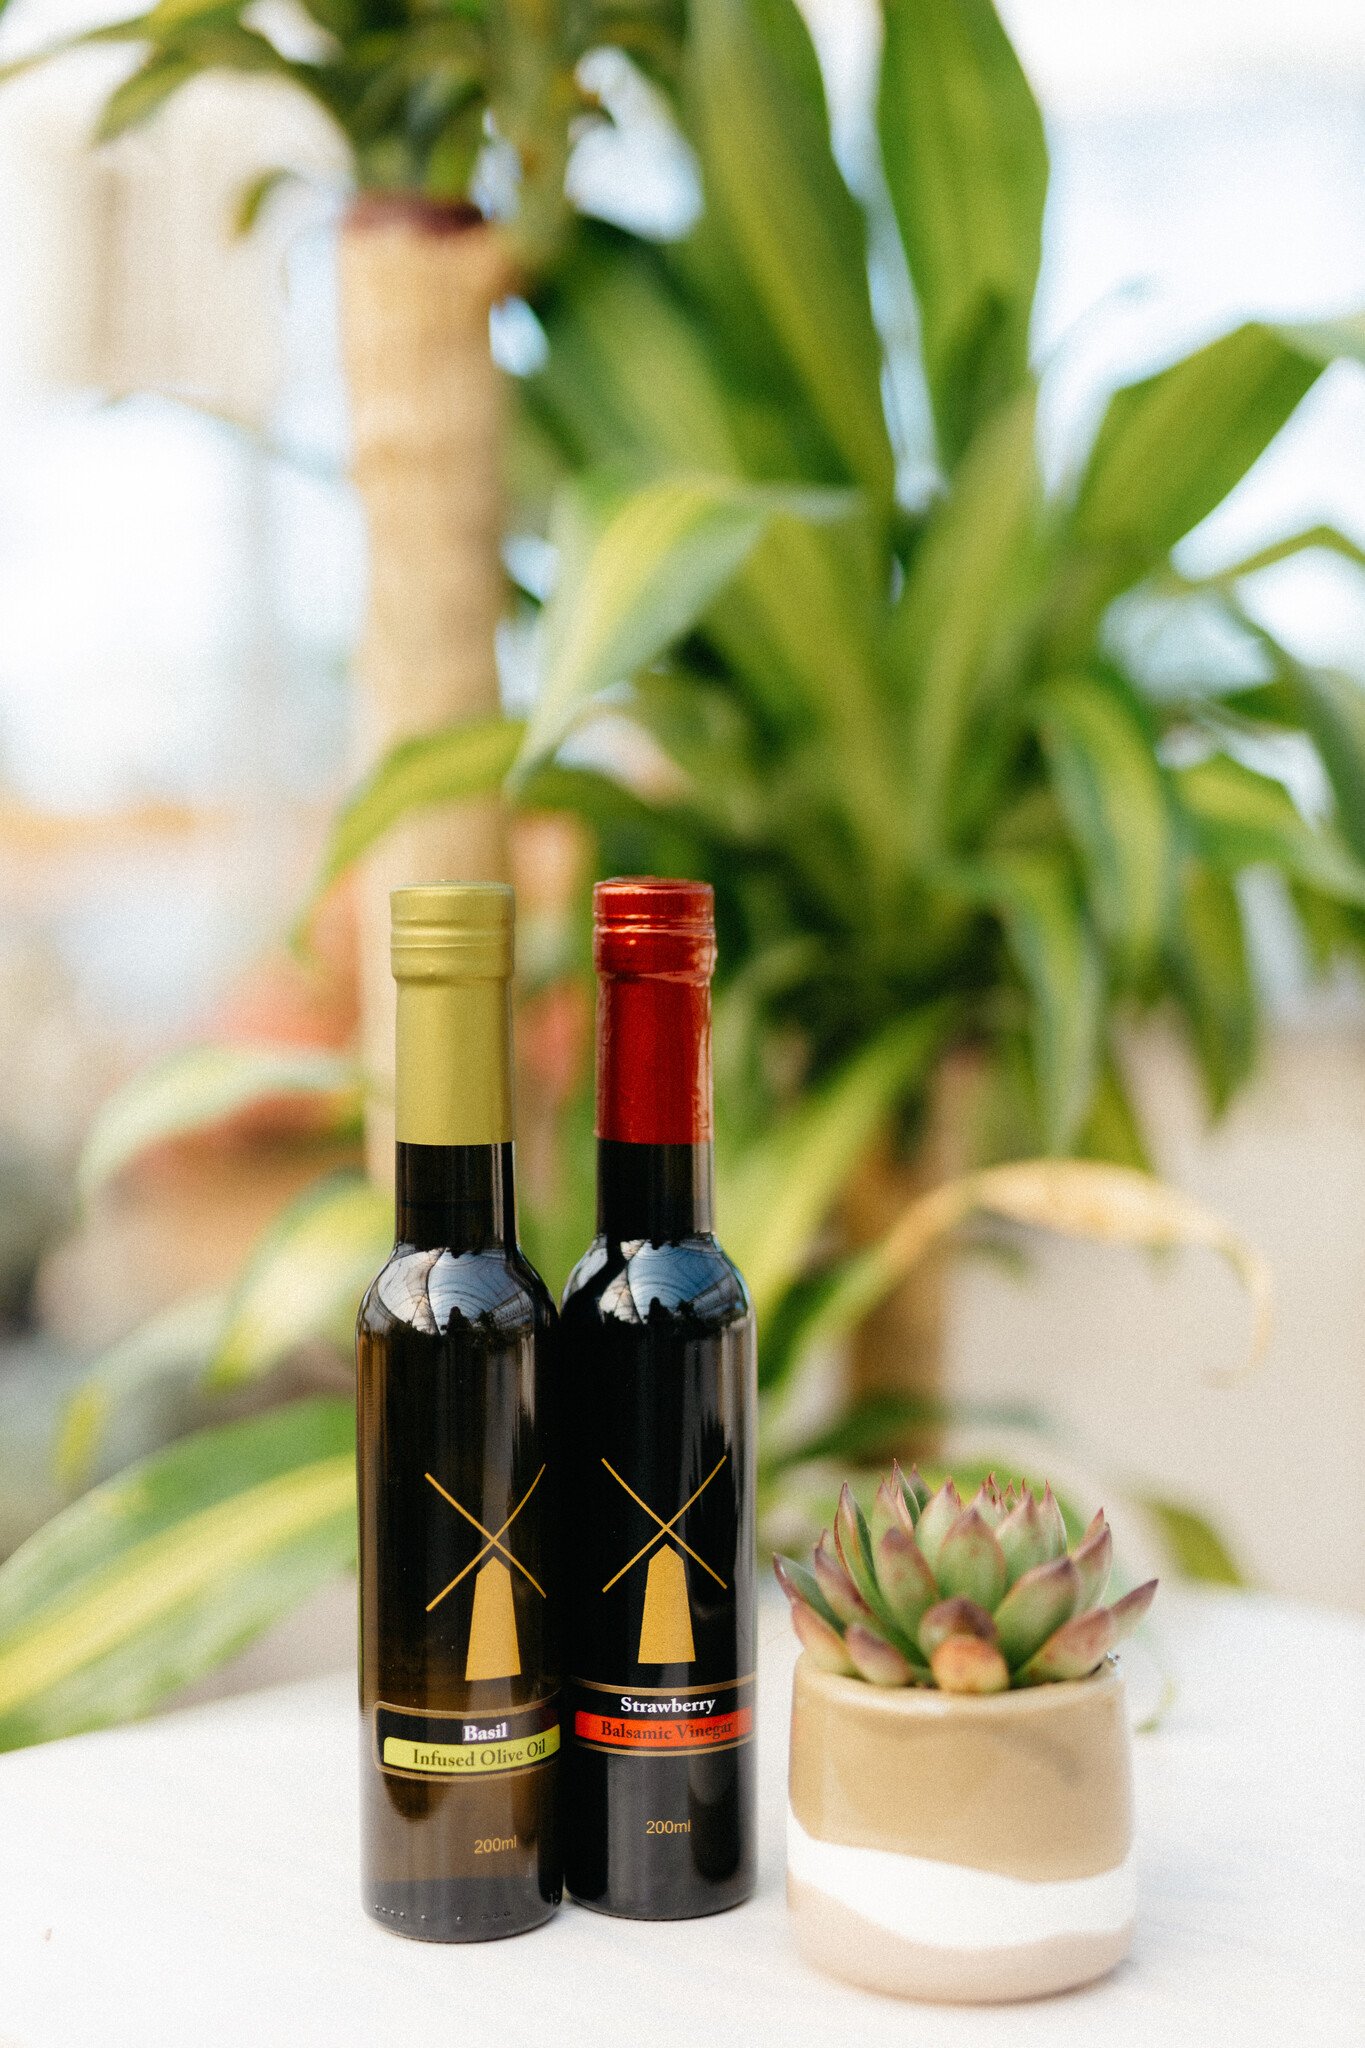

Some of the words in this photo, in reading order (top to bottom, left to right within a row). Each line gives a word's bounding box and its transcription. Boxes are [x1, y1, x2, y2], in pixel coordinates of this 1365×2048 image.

[620, 1697, 716, 1715] Strawberry
[463, 1722, 508, 1742] Basil
[600, 1720, 672, 1740] Balsamic
[676, 1720, 734, 1740] Vinegar
[413, 1747, 475, 1768] Infused
[480, 1746, 523, 1766] Olive
[526, 1737, 546, 1757] Oil
[646, 1819, 691, 1835] 200ml
[474, 1834, 517, 1854] 200ml
